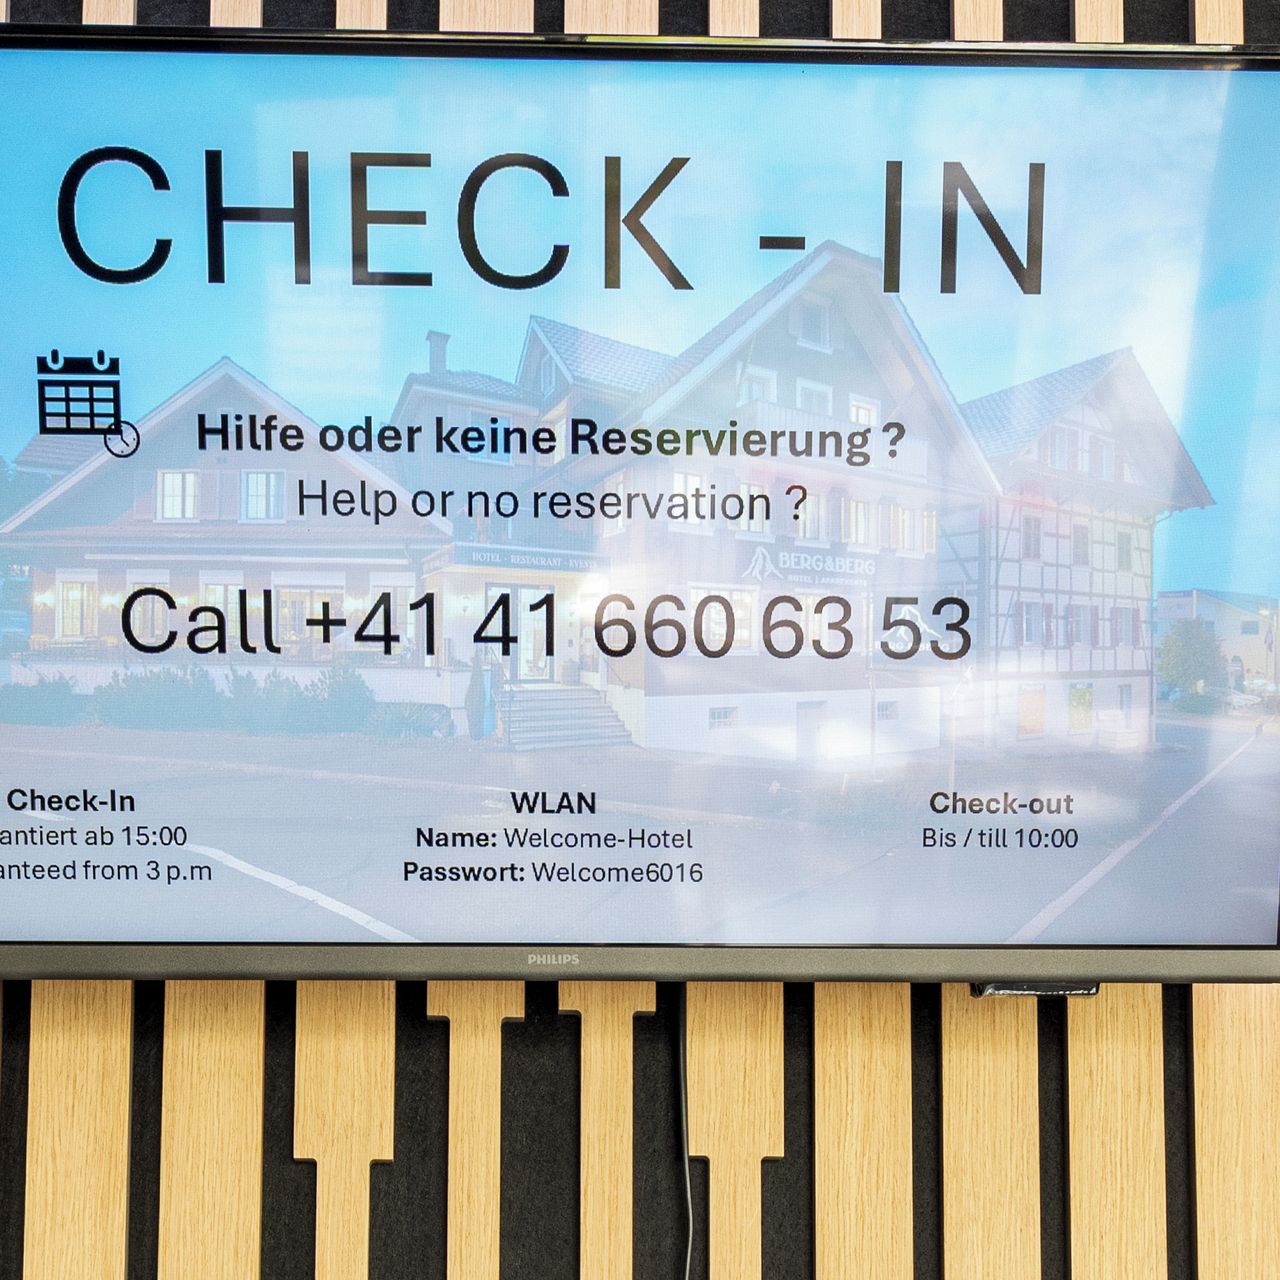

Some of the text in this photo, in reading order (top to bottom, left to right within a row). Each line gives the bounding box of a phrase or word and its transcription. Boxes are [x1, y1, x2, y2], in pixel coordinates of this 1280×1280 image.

[57, 145, 1046, 295] CHECK - IN
[197, 414, 906, 466] Hilfe oder keine Reservierung ?
[297, 480, 809, 525] Help or no reservation ?
[121, 586, 971, 660] Call +41 41 660 63 53
[6, 788, 136, 812] Check-In
[510, 791, 596, 814] WLAN
[929, 791, 1074, 815] Check-out
[84, 825, 114, 846] ab
[121, 825, 188, 846] 15:00
[416, 827, 693, 849] Name: Welcome-Hotel
[922, 827, 957, 848] Bis
[978, 828, 1008, 848] till
[1014, 828, 1079, 848] 10:00
[83, 860, 138, 881] from
[146, 859, 161, 881] 3
[167, 863, 212, 885] p.m
[403, 861, 703, 883] Passwort: Welcome6016
[527, 953, 580, 965] PHILIPS
